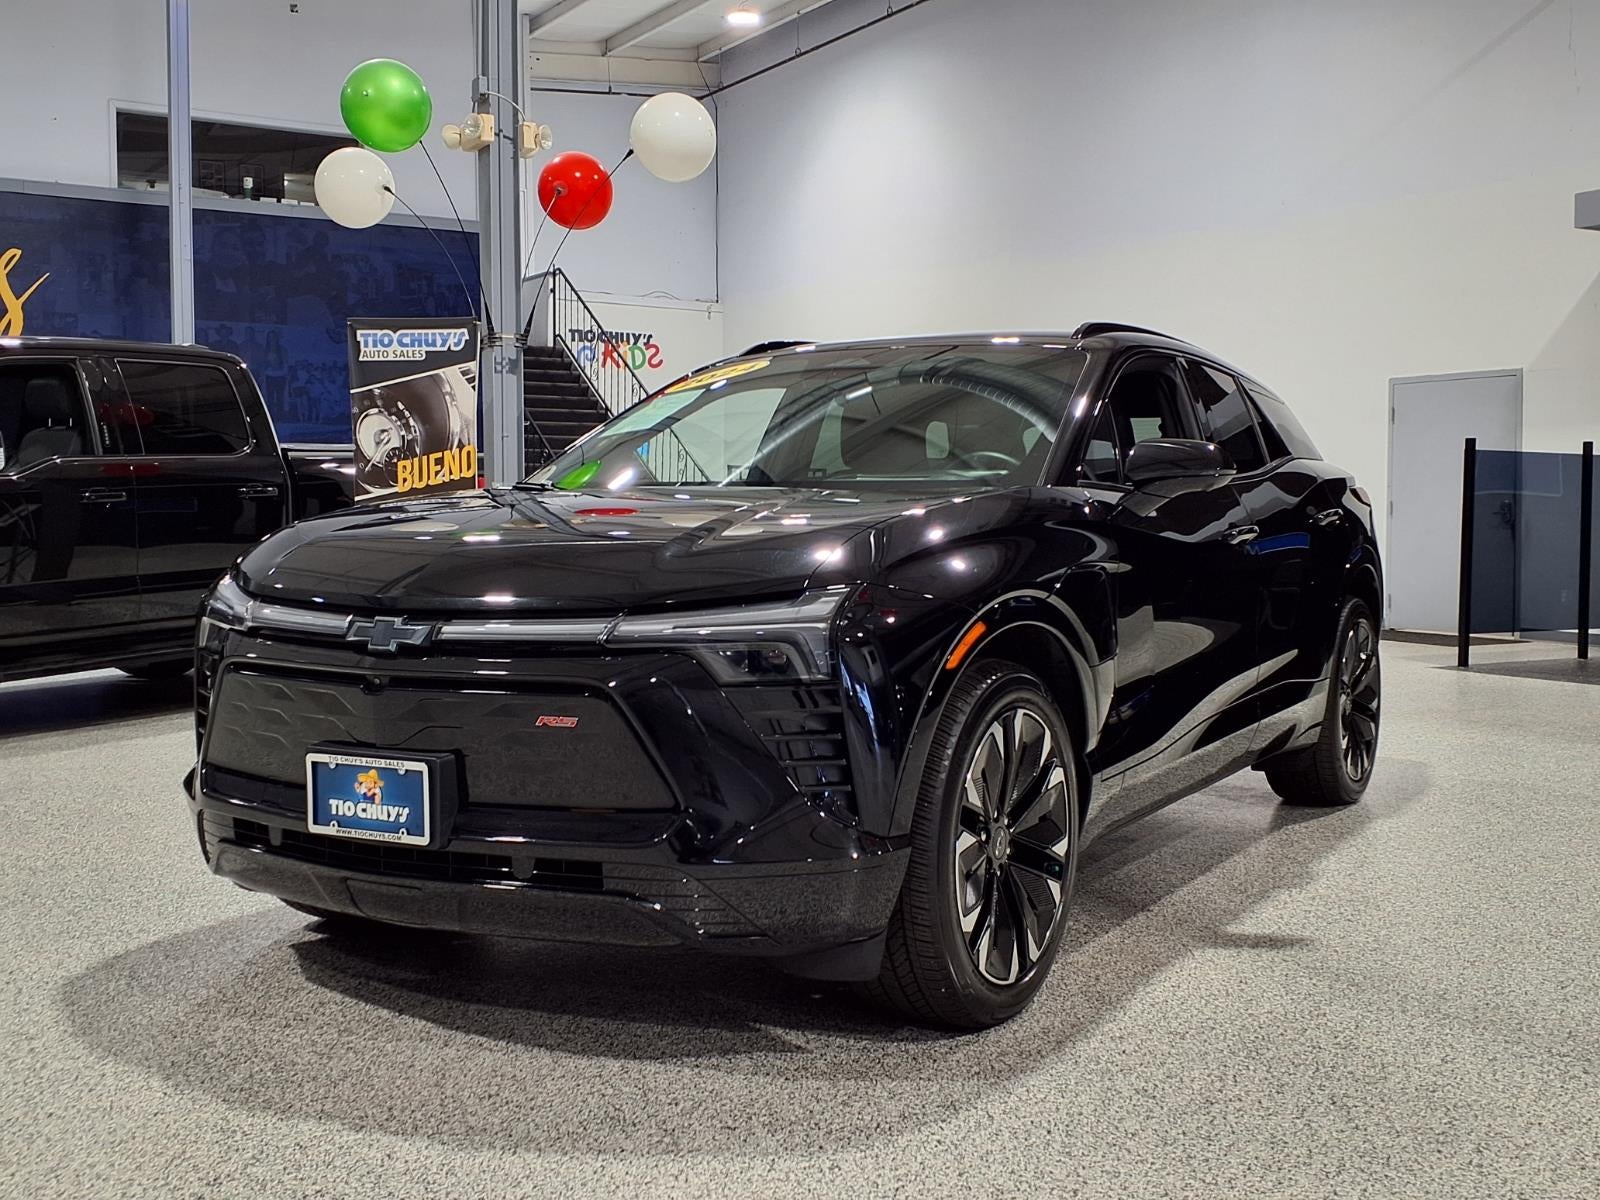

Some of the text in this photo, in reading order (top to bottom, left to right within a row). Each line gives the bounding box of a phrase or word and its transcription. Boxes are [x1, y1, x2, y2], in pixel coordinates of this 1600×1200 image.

[359, 331, 466, 349] TIO CHUY'S
[568, 328, 595, 343] TIO
[361, 350, 424, 360] AUTO SALES
[397, 443, 477, 493] BUENO
[535, 715, 579, 728] RS
[328, 755, 339, 763] TIO
[365, 758, 383, 766] AUTO
[384, 760, 405, 769] SALES
[328, 798, 410, 823] TIO CHUY'S
